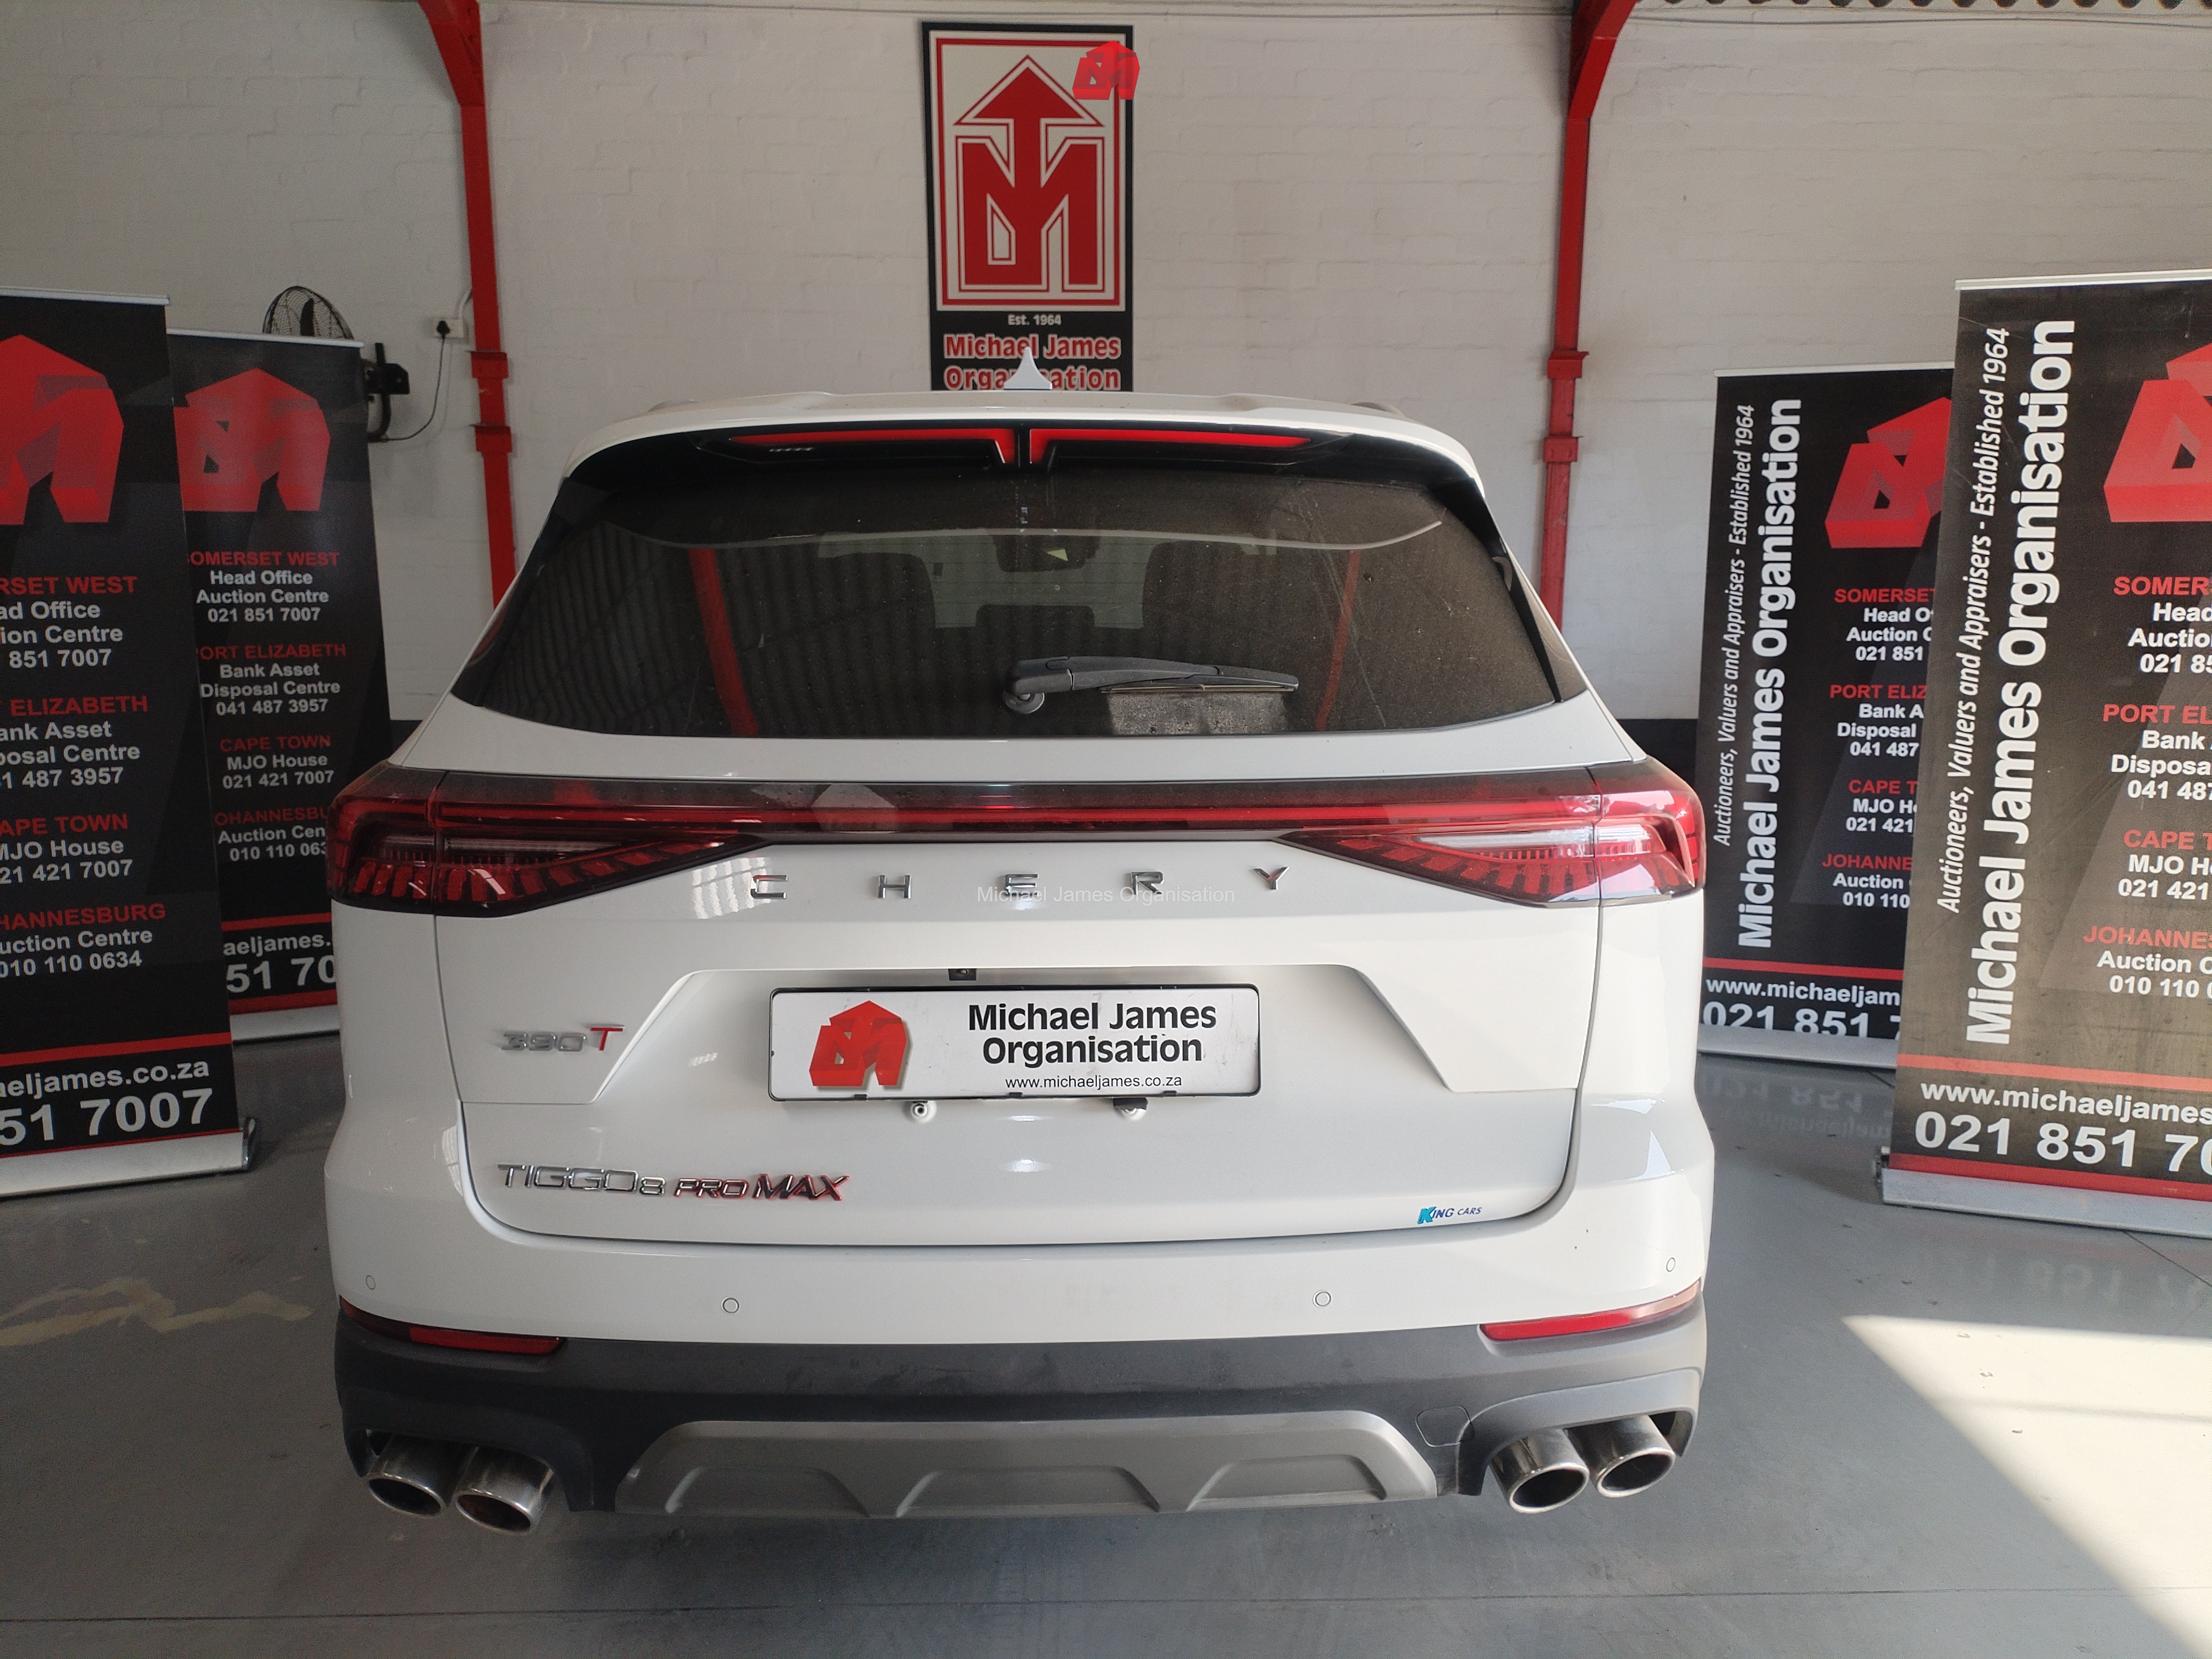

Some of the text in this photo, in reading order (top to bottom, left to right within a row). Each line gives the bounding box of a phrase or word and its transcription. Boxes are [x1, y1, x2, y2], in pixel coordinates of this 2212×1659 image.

[1008, 314, 1062, 326] Est. 1964
[944, 333, 1121, 360] Michael James
[1983, 327, 2010, 383] 1964
[944, 365, 1121, 390] Orgaation
[1735, 404, 1755, 446] 1964
[1970, 389, 2004, 517] Established
[1728, 450, 1751, 545] Established
[187, 551, 339, 565] OMERSET WEST
[65, 576, 137, 594] WEST
[210, 570, 313, 584] Head Office
[2114, 576, 2212, 596] SOMER
[195, 589, 329, 604] Auction Centre
[1723, 558, 1745, 645] Appraisers
[1959, 534, 1991, 650] Appraisers
[31, 601, 101, 619] Office
[207, 607, 321, 622] 021 851 7007
[1863, 607, 1911, 622] Head
[45, 625, 124, 643] Centre
[1846, 626, 1918, 642] Auction
[2127, 628, 2212, 648] Auctio
[9, 649, 112, 668] 851 7007
[196, 643, 346, 660] ORT ELIZABETH
[1856, 646, 1923, 661] 021 851
[220, 663, 320, 678] Bank Asset
[1721, 647, 1740, 680] and
[2140, 653, 2182, 673] 021
[1738, 399, 1802, 948] Michael James Organisation
[1956, 652, 1981, 696] and
[1966, 320, 2075, 1045] Michael James Organisation
[200, 680, 340, 699] Disposal Centre
[1830, 684, 1882, 699] PORT
[10, 696, 148, 716] ELIZABETH
[216, 698, 328, 716] 041 487 3957
[1717, 683, 1738, 742] Valuers
[1858, 703, 1905, 718] Bank
[2103, 704, 2175, 723] PORT
[45, 721, 112, 739] Asset
[1837, 722, 1916, 740] Disposal
[1947, 700, 1977, 777] Valuers
[2141, 729, 2206, 750] Bank
[63, 744, 140, 763] Centre
[220, 734, 331, 753] CAPE TOWN
[1849, 741, 1919, 757] 041 487
[227, 754, 328, 771] MJO House
[2111, 753, 2212, 778] Disposa
[22, 770, 62, 787] 487
[71, 766, 124, 786] 3957
[222, 770, 334, 789] 021 421 7007
[1848, 779, 1901, 794] CAPE
[1713, 748, 1738, 846] Auctioneers,
[2127, 779, 2169, 799] 041
[1853, 798, 1894, 813] MJO
[55, 813, 127, 833] TOWN
[1846, 817, 1913, 833] 021 421
[218, 828, 286, 844] Auction
[2123, 829, 2195, 850] CAPE
[51, 839, 124, 858] House
[230, 846, 260, 861] 010
[266, 844, 294, 858] 110
[1937, 786, 1974, 913] Auctioneers,
[32, 861, 71, 881] 421
[80, 859, 133, 879] 7007
[1822, 854, 1912, 871] JOHANNE
[2128, 854, 2184, 875] MJO
[751, 865, 1290, 900] CHERY
[1833, 872, 1904, 889] Auction
[2118, 878, 2209, 900] 021 421
[1843, 892, 1910, 908] 010 110
[78, 928, 153, 949] Centre
[2083, 925, 2212, 949] JOHANNE
[44, 954, 82, 974] 110
[90, 950, 143, 971] 0634
[2096, 950, 2191, 974] Auction
[226, 960, 272, 994] 51
[2109, 975, 2152, 995] 010
[2160, 977, 2199, 998] 110
[968, 1002, 1217, 1031] Michael James
[1703, 1001, 1774, 1030] 021
[1795, 1008, 1869, 1037] 851
[983, 1034, 1203, 1068] Organisation
[1004, 1074, 1183, 1090] www.michaeljames.co.za
[80, 1088, 213, 1136] 7007
[1916, 1111, 2010, 1155] 021
[2037, 1123, 2136, 1167] 851
[673, 1177, 750, 1199] PRO
[751, 1172, 850, 1202] MAX
[1417, 1206, 1455, 1225] KING
